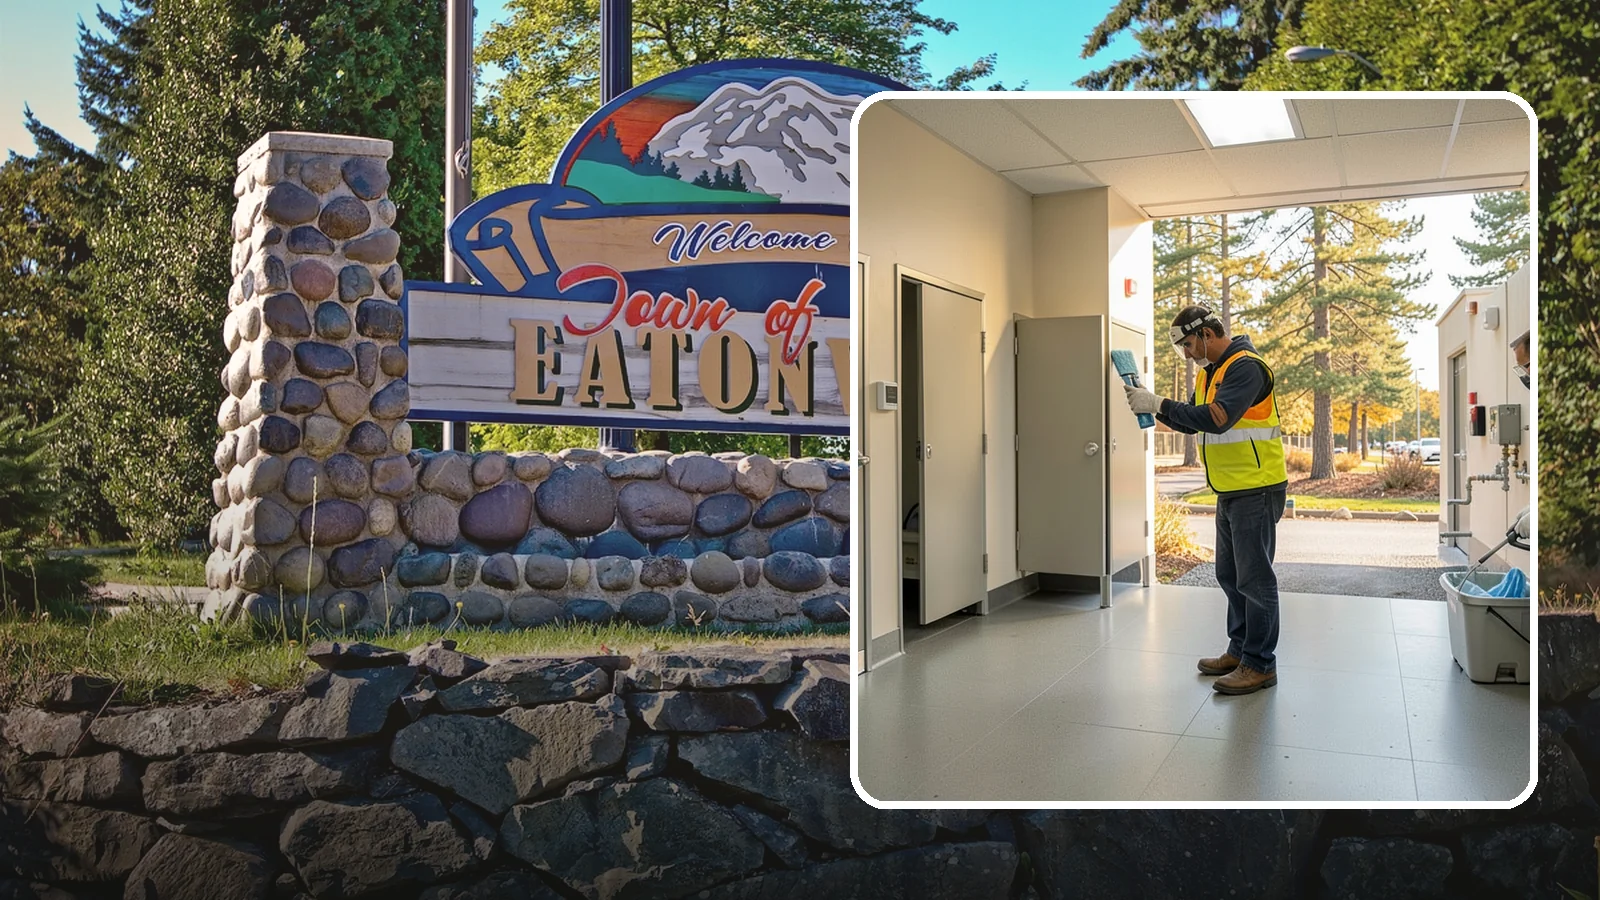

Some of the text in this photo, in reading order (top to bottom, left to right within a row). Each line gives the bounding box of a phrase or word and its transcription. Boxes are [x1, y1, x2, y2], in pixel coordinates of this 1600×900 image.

[653, 220, 837, 263] Welcome
[556, 263, 826, 365] Town of
